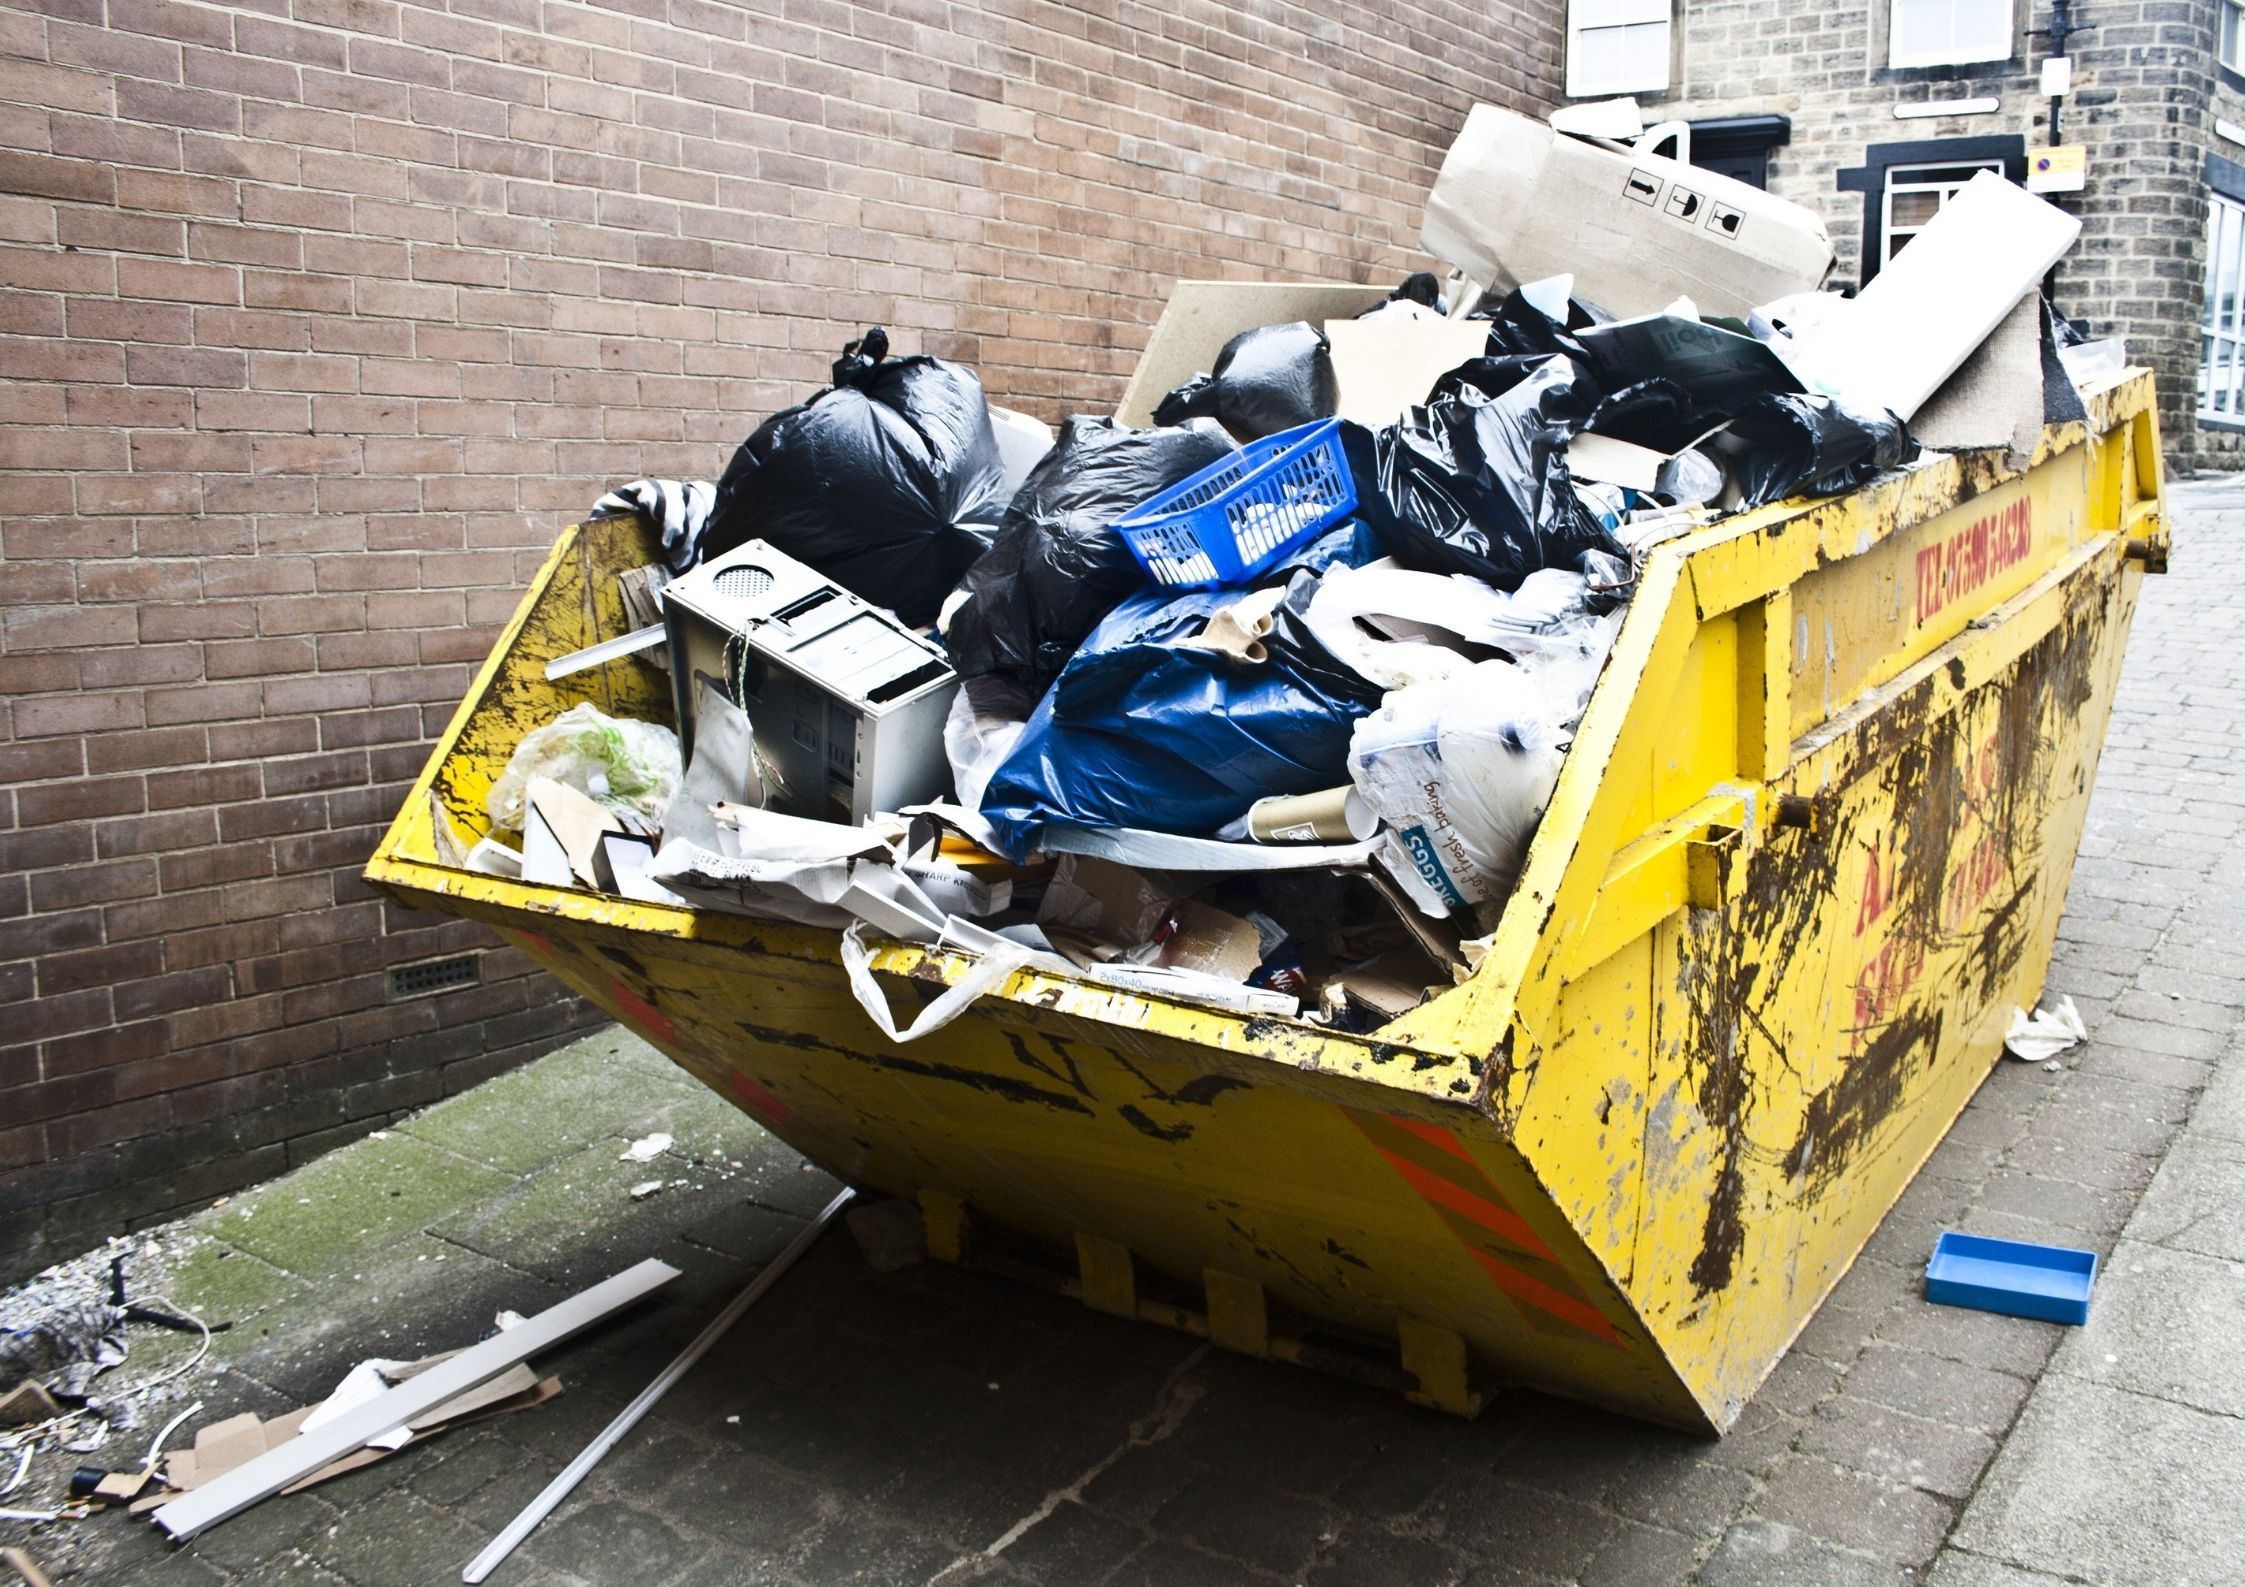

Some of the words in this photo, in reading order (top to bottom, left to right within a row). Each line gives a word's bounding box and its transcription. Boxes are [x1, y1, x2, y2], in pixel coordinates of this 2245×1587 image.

[1916, 542, 1942, 622] TEL
[1423, 781, 1452, 832] baking
[1442, 831, 1473, 873] fresh
[1461, 873, 1483, 887] of
